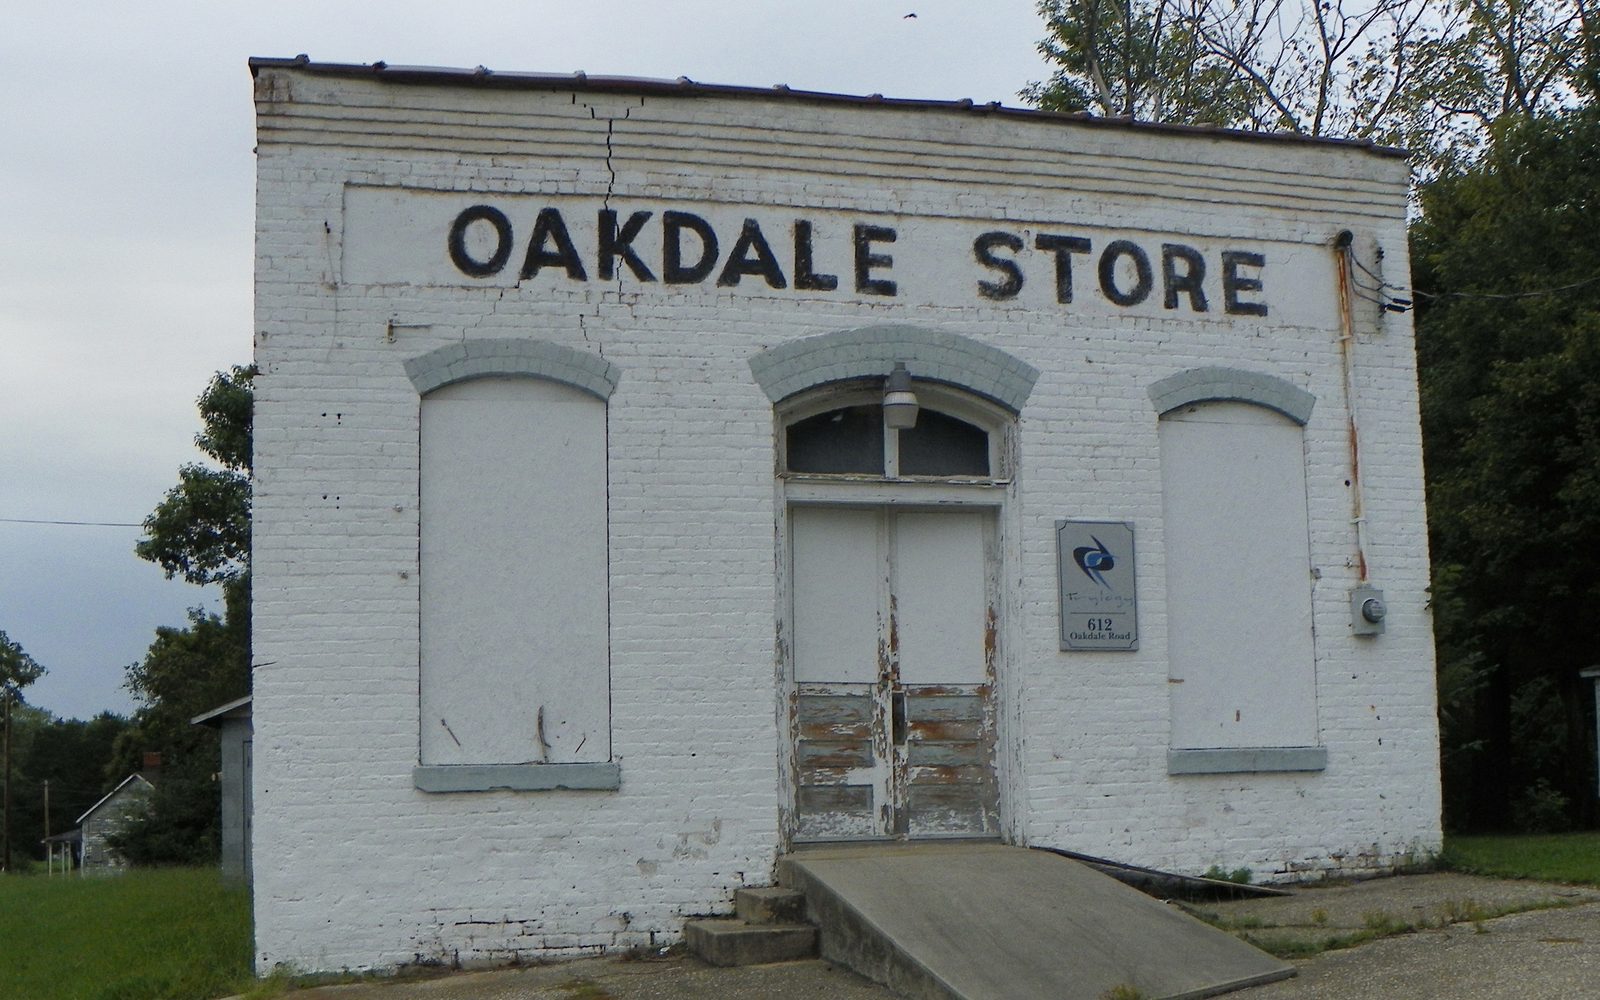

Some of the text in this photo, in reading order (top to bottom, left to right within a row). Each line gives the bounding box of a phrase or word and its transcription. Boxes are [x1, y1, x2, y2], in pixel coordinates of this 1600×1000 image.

[447, 203, 1268, 317] OAKDALE STORE
[1087, 618, 1113, 631] 612
[1069, 631, 1131, 640] Oakdale Road
